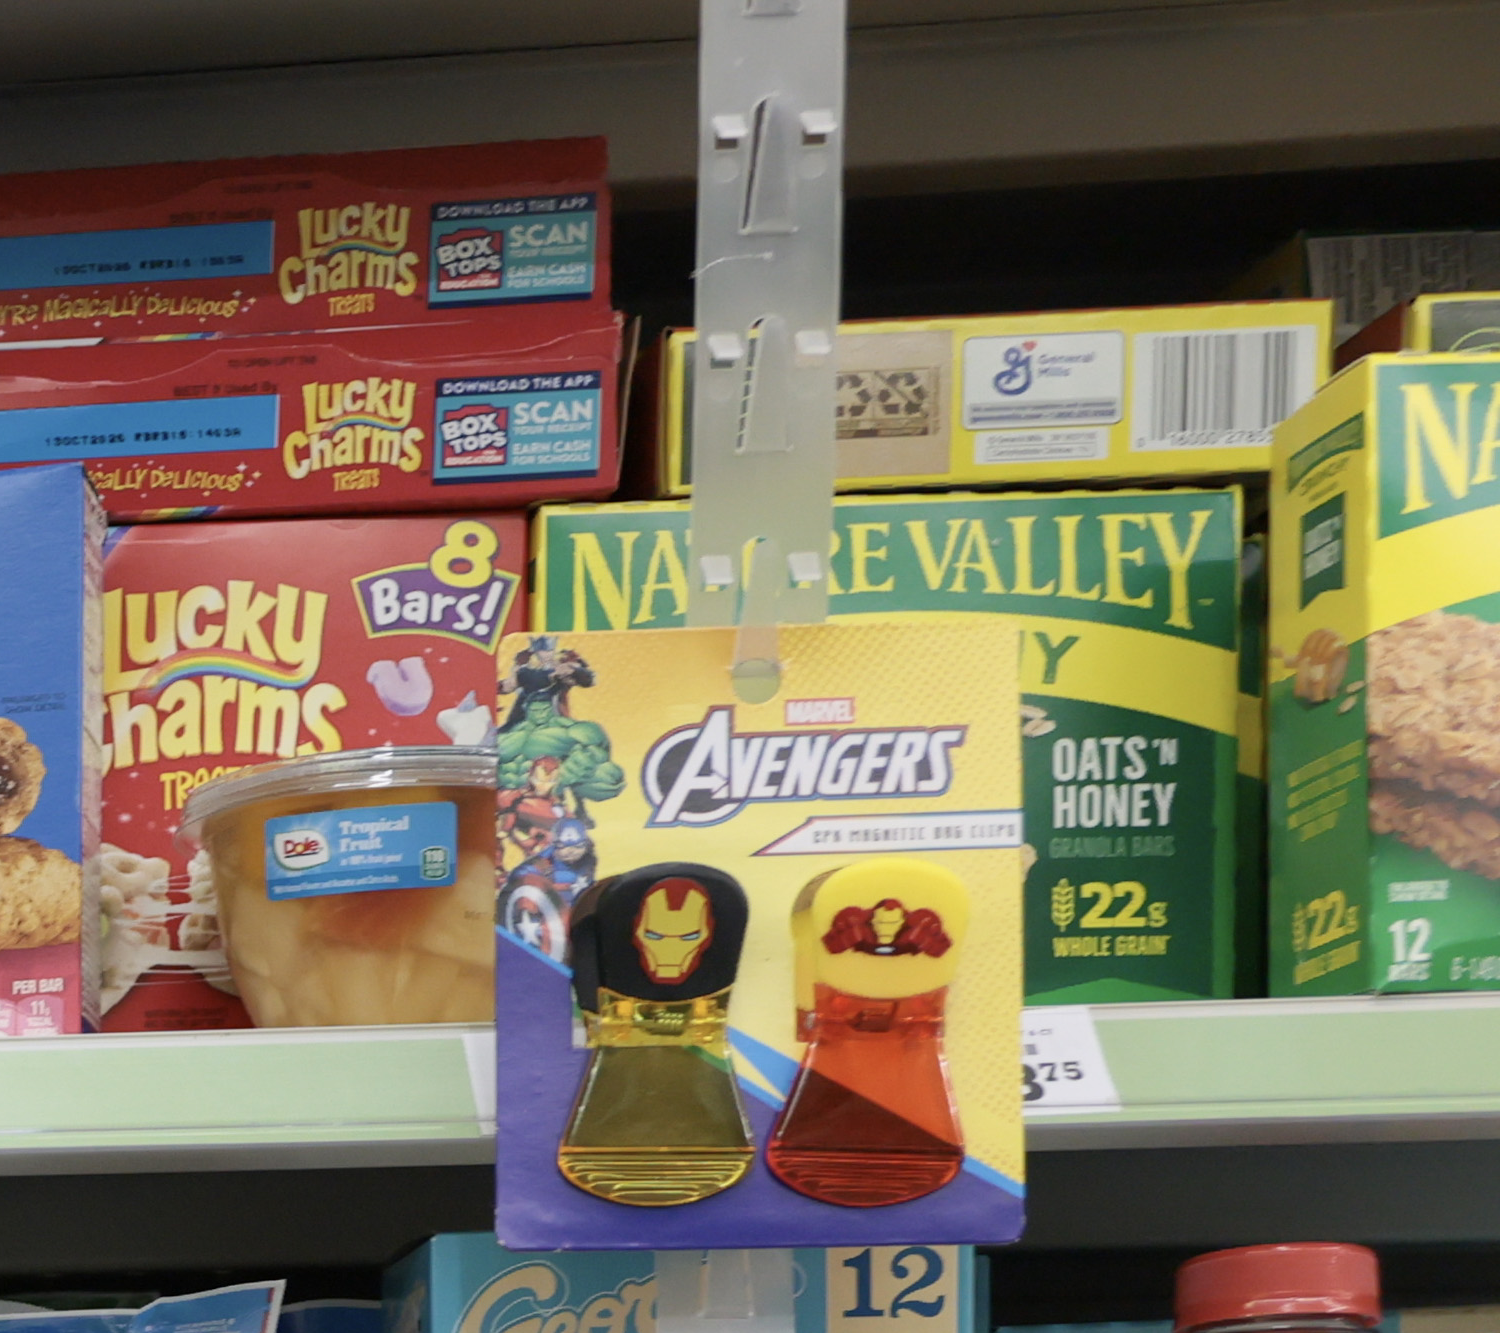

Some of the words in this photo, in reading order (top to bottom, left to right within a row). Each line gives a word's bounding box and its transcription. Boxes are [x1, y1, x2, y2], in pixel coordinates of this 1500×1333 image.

[298, 201, 411, 256] Lucky
[436, 202, 514, 221] DOWNLOAD
[520, 200, 549, 216] THE
[554, 198, 589, 214] APP
[509, 221, 588, 249] SCAN
[278, 247, 419, 305] Charms
[440, 411, 496, 438] BOX
[449, 428, 507, 453] TOPS
[429, 521, 498, 588] 8
[571, 518, 894, 631] NARE
[906, 510, 1213, 631] VALLEY
[366, 577, 495, 637] Bars!
[102, 579, 328, 692] Lucky
[786, 698, 855, 723] MARVEL
[648, 705, 966, 827] AVENGERS
[1052, 736, 1146, 782] OATS
[1052, 783, 1179, 830] HONEY
[283, 837, 322, 856] Dole
[1079, 880, 1168, 929] 22g
[1053, 936, 1111, 957] WHOLE
[1115, 934, 1171, 956] GRAIN
[842, 1246, 944, 1319] 12
